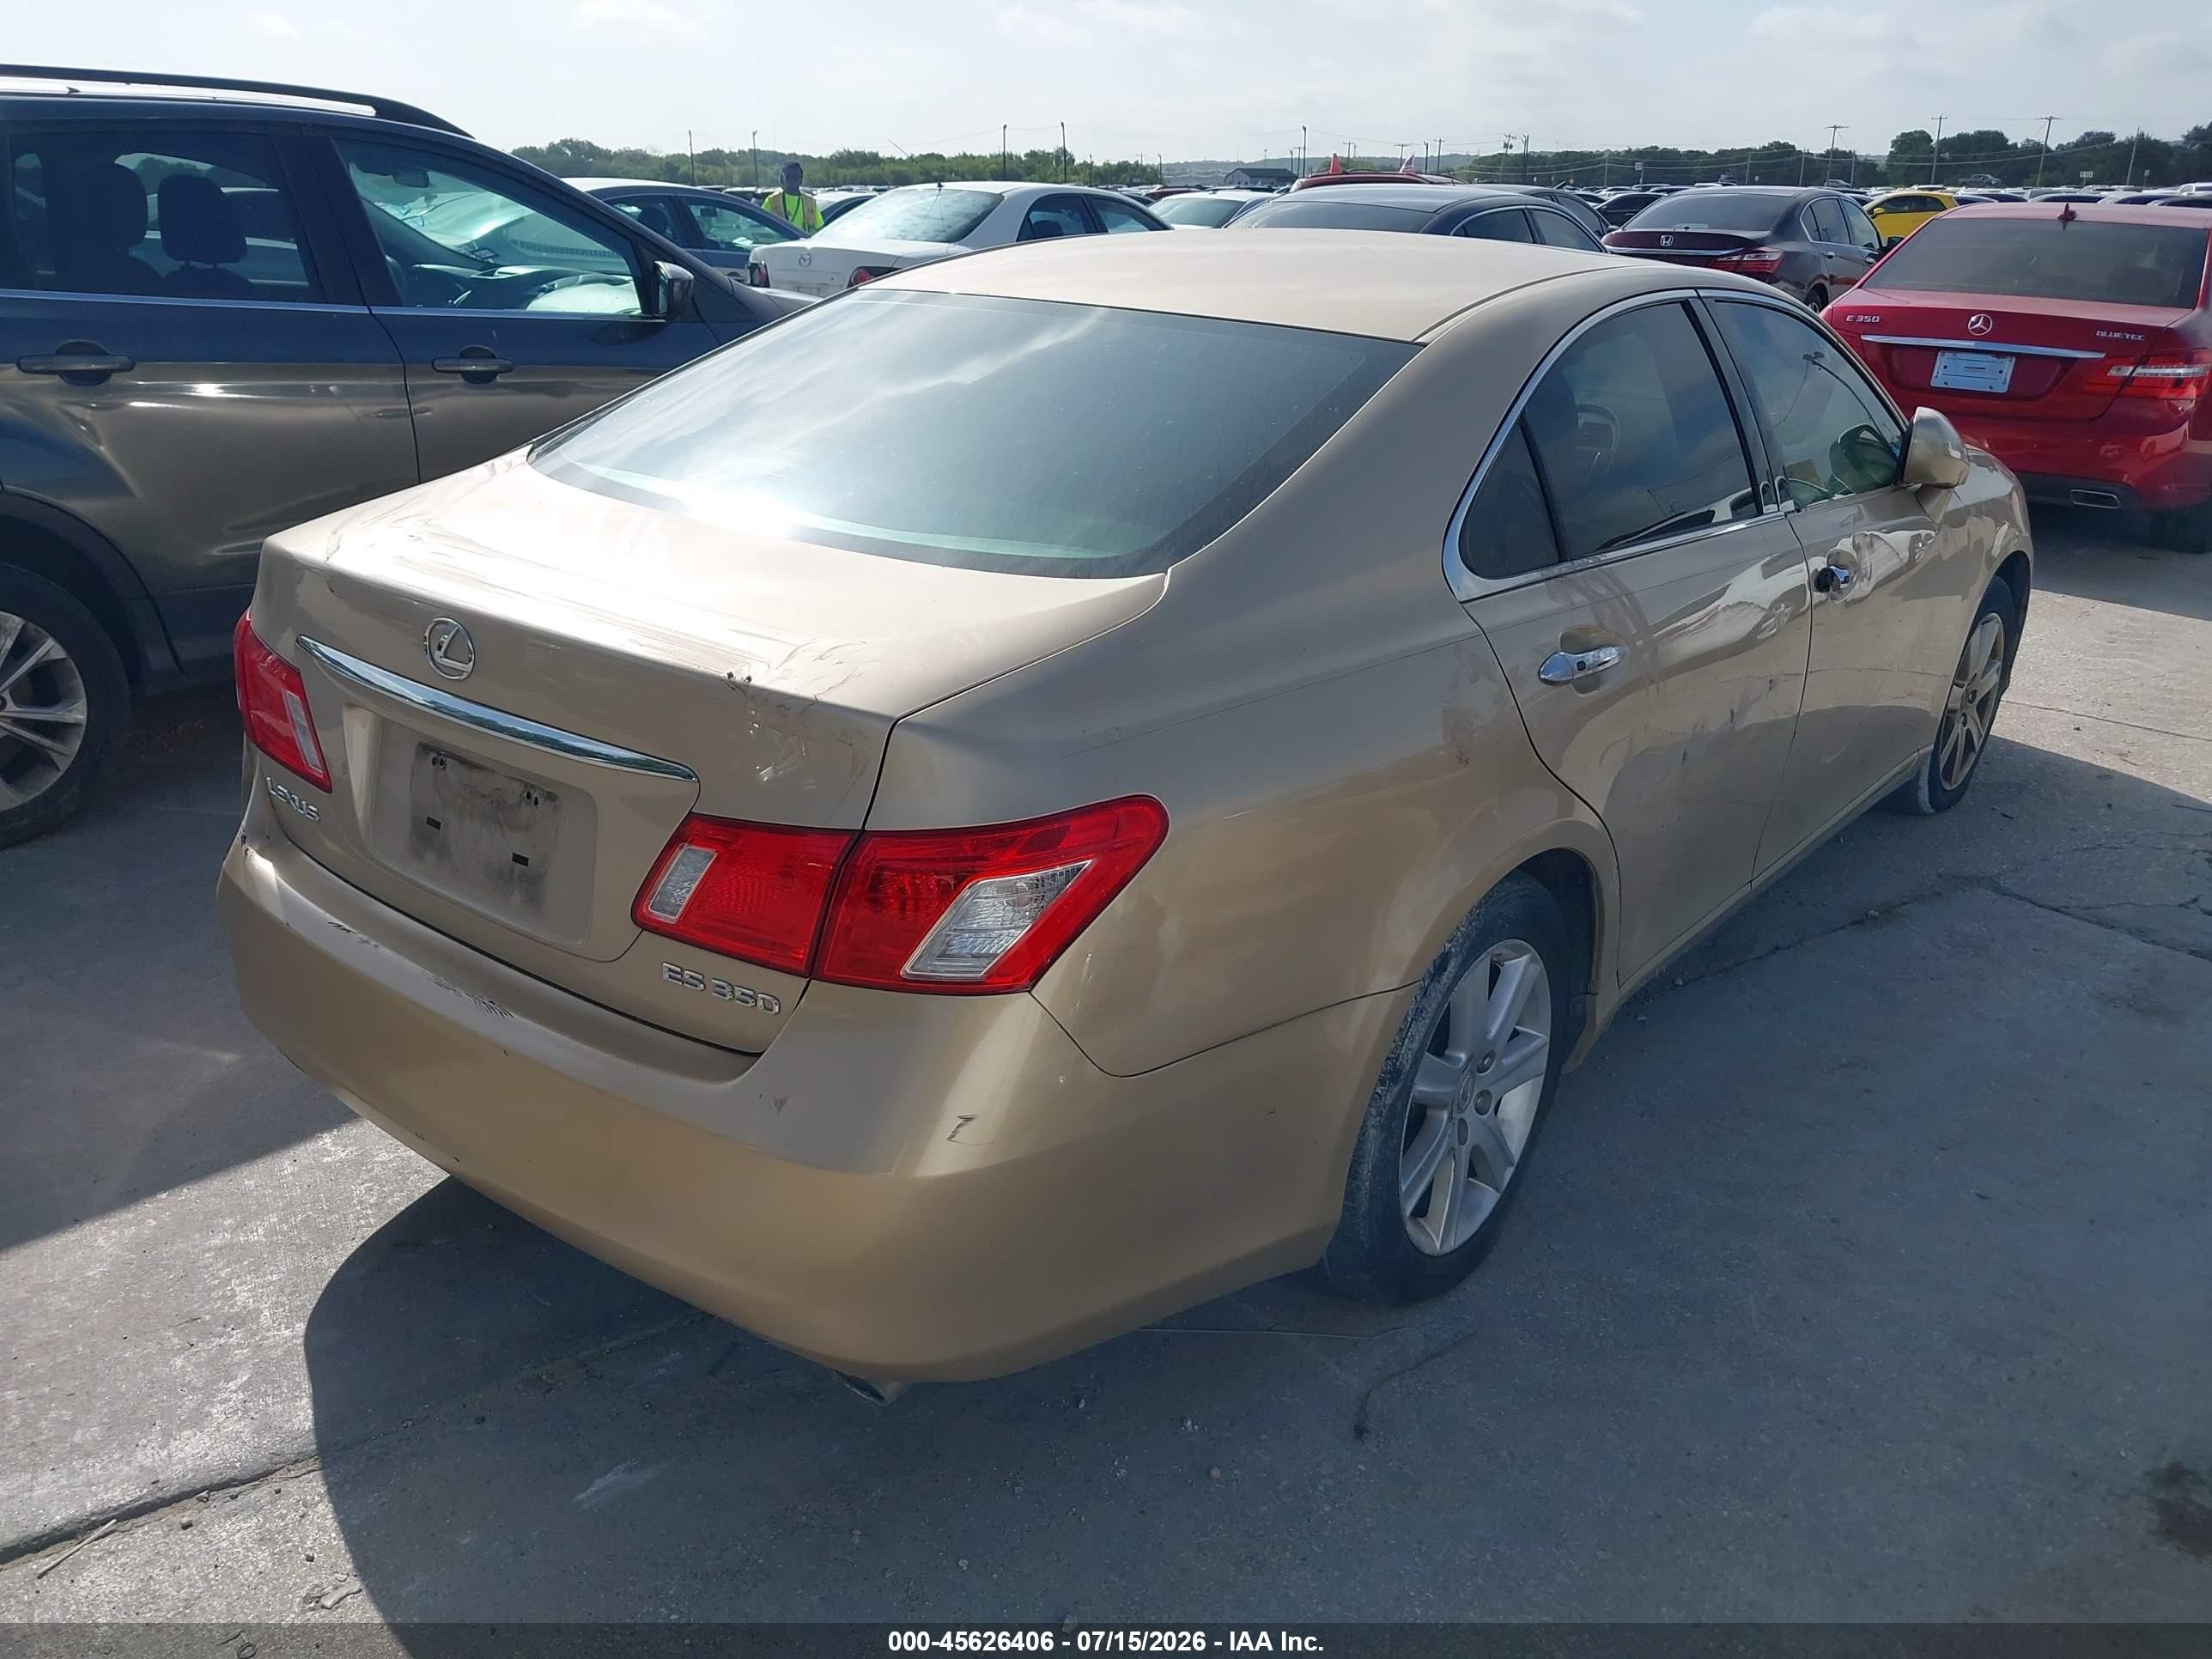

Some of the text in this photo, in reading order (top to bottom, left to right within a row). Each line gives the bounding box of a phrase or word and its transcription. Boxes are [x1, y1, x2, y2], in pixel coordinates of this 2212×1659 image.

[266, 776, 320, 822] LEXUS
[662, 962, 781, 1015] ES 350
